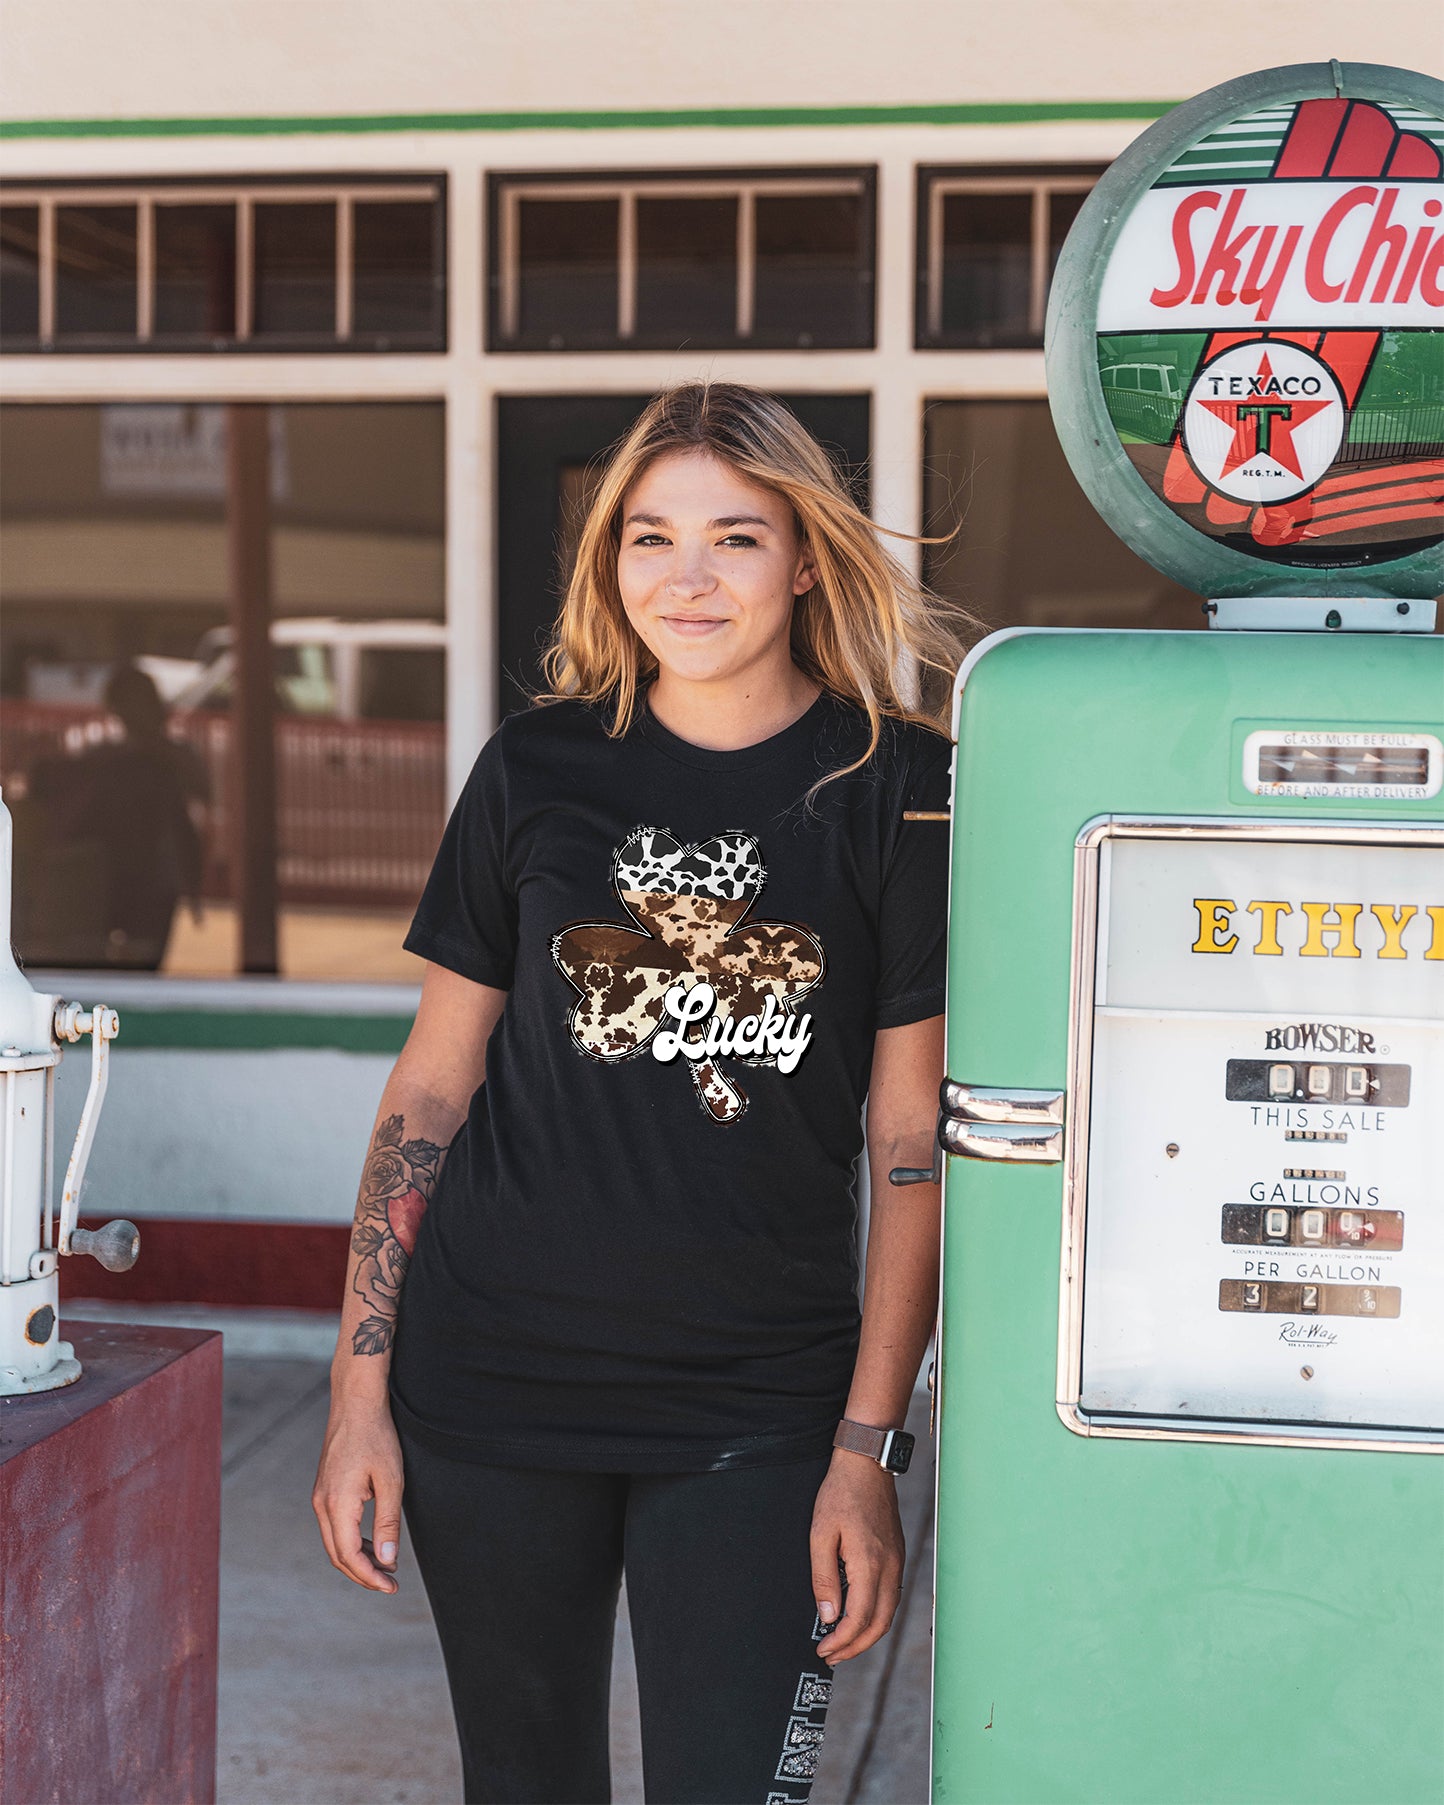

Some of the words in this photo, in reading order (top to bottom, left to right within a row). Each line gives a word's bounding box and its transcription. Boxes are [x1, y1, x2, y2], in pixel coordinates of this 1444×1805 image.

[1150, 188, 1304, 321] Sky
[1208, 376, 1321, 396] TEXACO
[1284, 734, 1321, 745] GLASS
[1326, 735, 1358, 745] MUST
[1363, 736, 1377, 746] BE
[1381, 736, 1407, 746] FULL
[1258, 785, 1299, 796] BEFORE
[1305, 786, 1329, 796] AND
[1334, 786, 1370, 797] AFTER
[1375, 787, 1428, 798] DELIVERY
[652, 982, 813, 1075] Lucky
[1265, 1023, 1376, 1054] BOWSER
[1251, 1106, 1308, 1128] THIS
[1322, 1110, 1385, 1131] SALE
[1250, 1182, 1379, 1206] GALLONS
[1244, 1261, 1280, 1276] PER
[1296, 1264, 1380, 1281] GALLON
